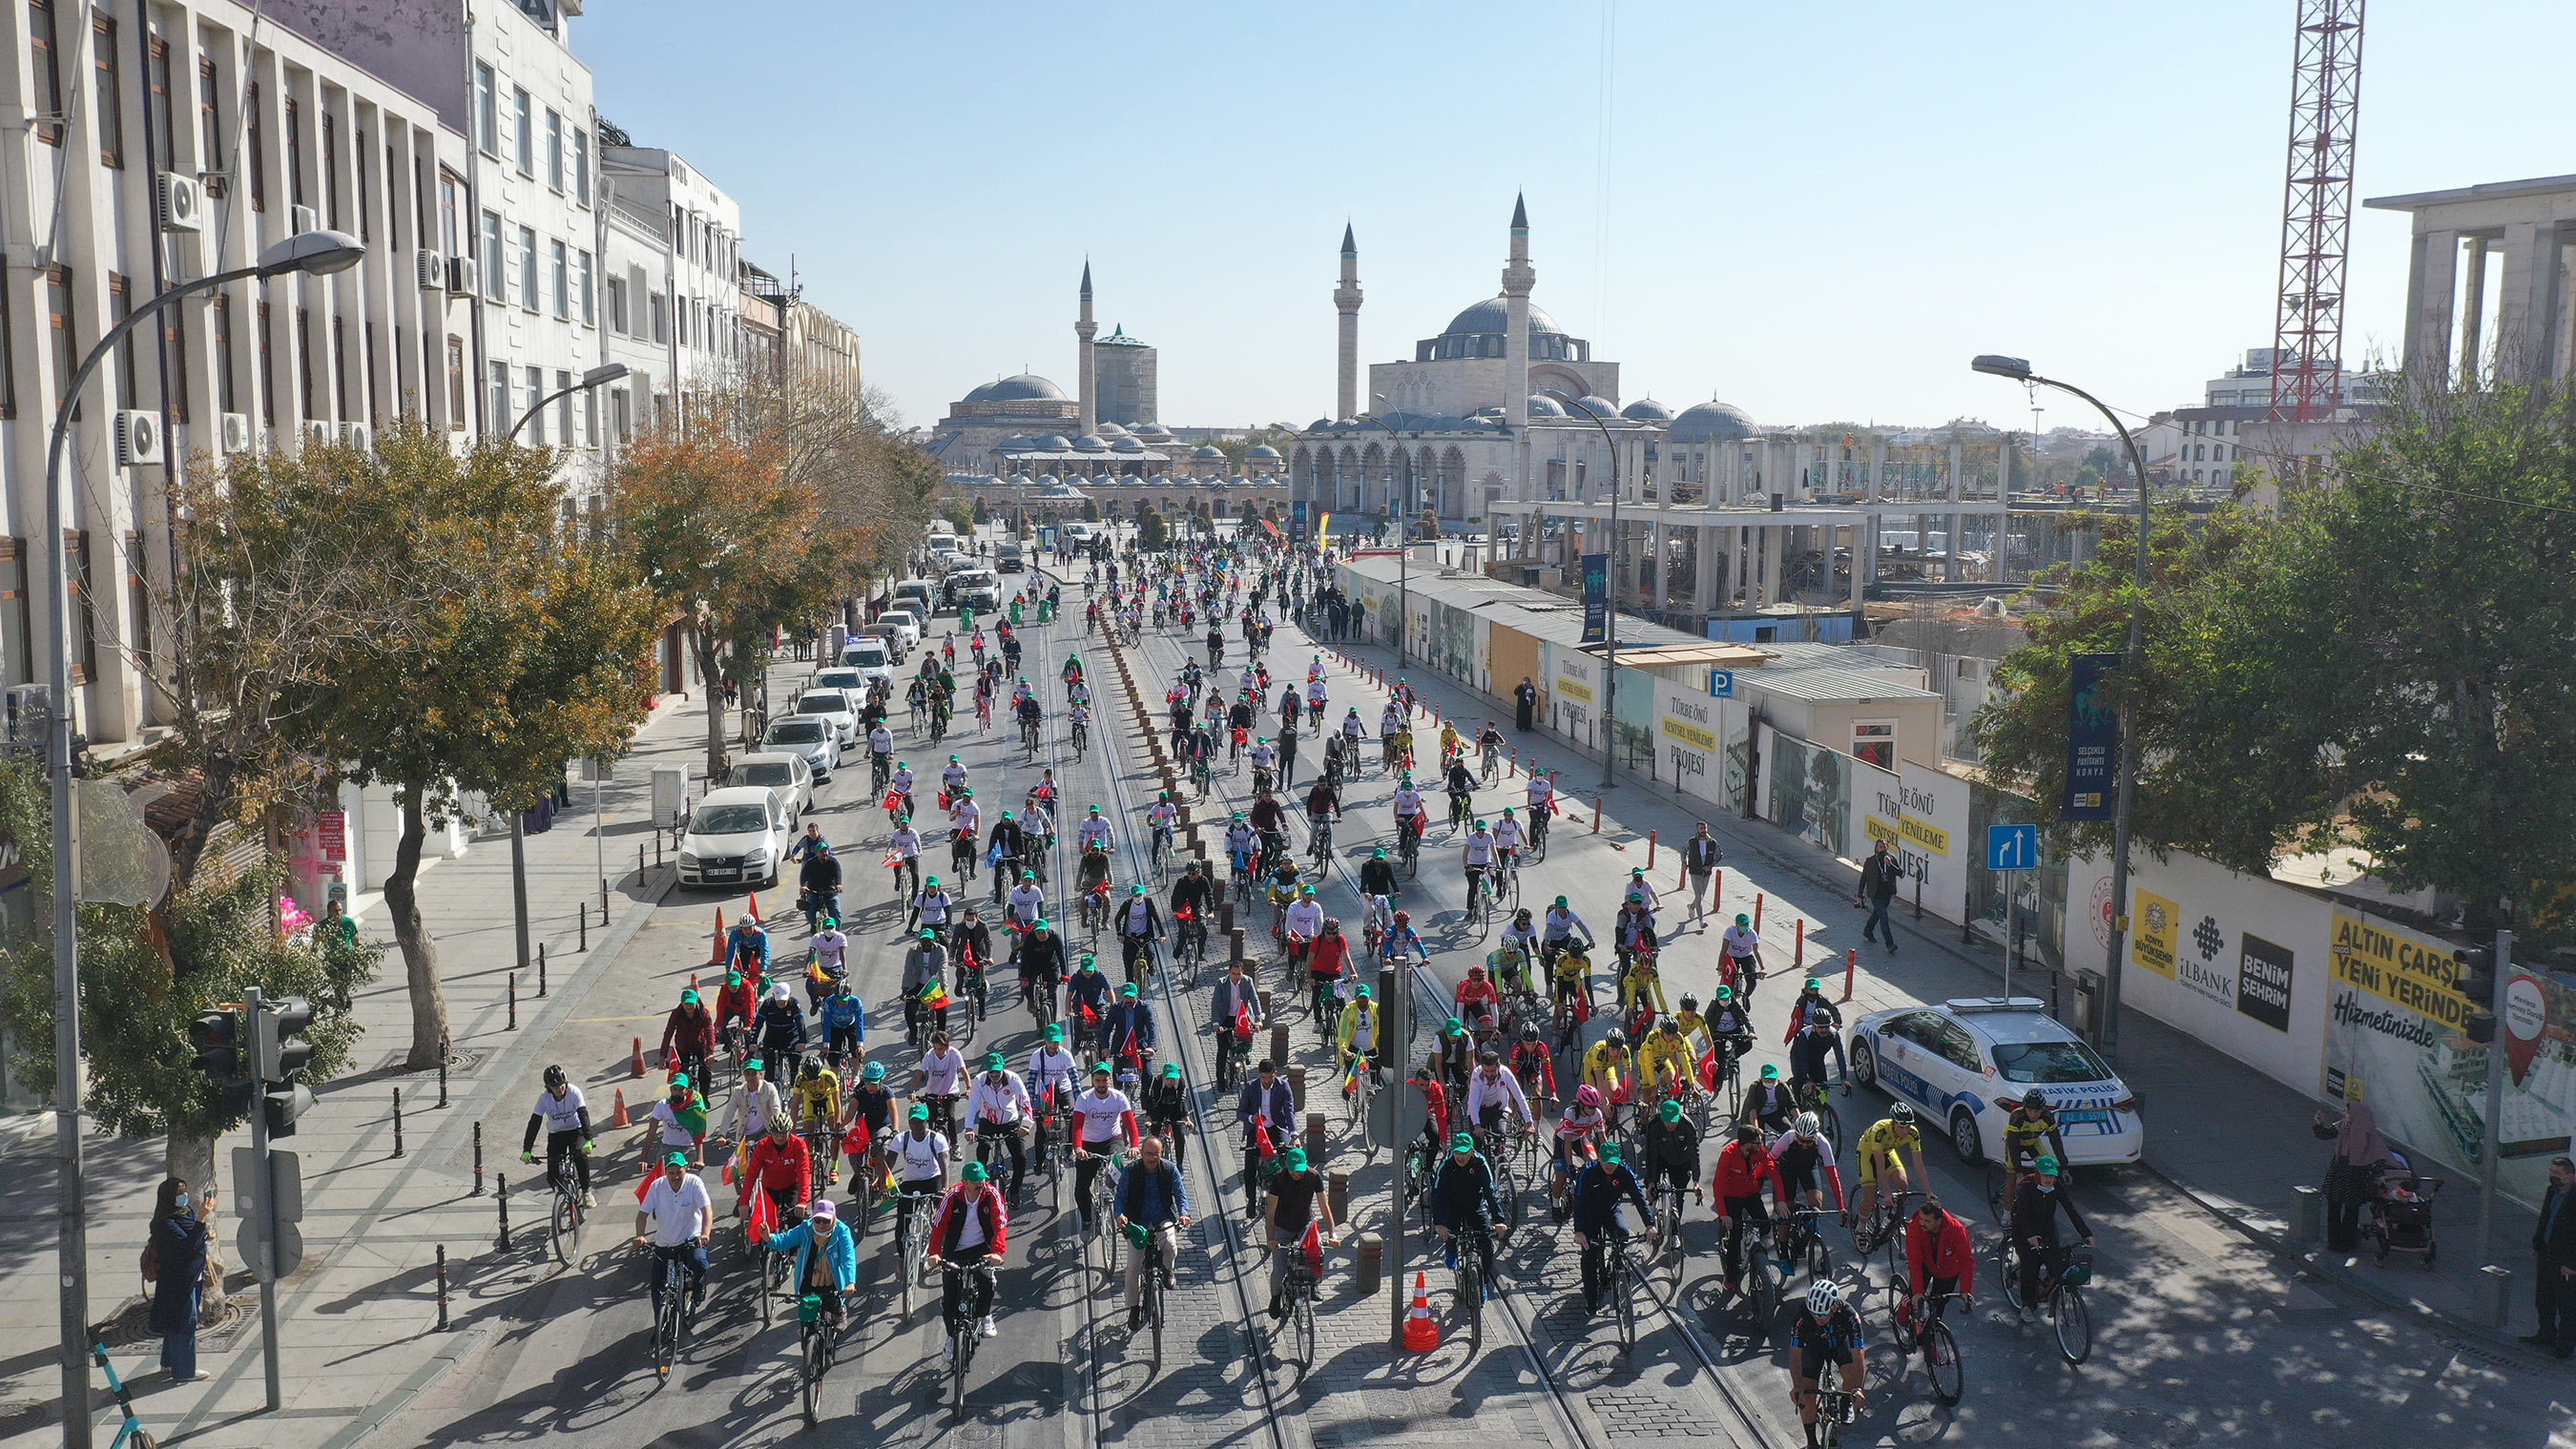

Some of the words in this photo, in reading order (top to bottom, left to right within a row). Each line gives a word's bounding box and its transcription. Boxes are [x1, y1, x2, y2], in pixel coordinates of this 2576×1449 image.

[1715, 673, 1728, 695] P
[1563, 700, 1587, 725] PROJESİ
[1672, 696, 1693, 719] TÜRBE
[1693, 704, 1708, 724] ÖNÜ
[1665, 720, 1687, 740] KENTSEL
[1686, 726, 1714, 749] YENİLEME
[1671, 745, 1705, 776] PROJESİ
[2077, 756, 2105, 766] PAYİTAHTI
[2078, 746, 2106, 756] SELÇUKLU
[2076, 768, 2104, 776] KONYA
[1911, 787, 1934, 816] ÖNÜ
[1901, 818, 1944, 850] YENİLEME
[2135, 939, 2173, 964] BÜYÜKŞEHİR
[2145, 933, 2164, 949] KONYA
[2337, 921, 2394, 963] ALTIN
[2243, 954, 2289, 989] BENİM
[2242, 977, 2287, 1010] ŞEHRİM
[2337, 955, 2381, 992] YENİ
[2386, 972, 2475, 1030] YERİNDE
[2334, 990, 2435, 1048] Hizmetinizde
[1880, 1062, 1900, 1085] TRAFİK
[1901, 1072, 1919, 1096] POLİSİ
[2040, 1087, 2079, 1095] RAFİK
[2079, 1083, 2119, 1094] POLİSİ
